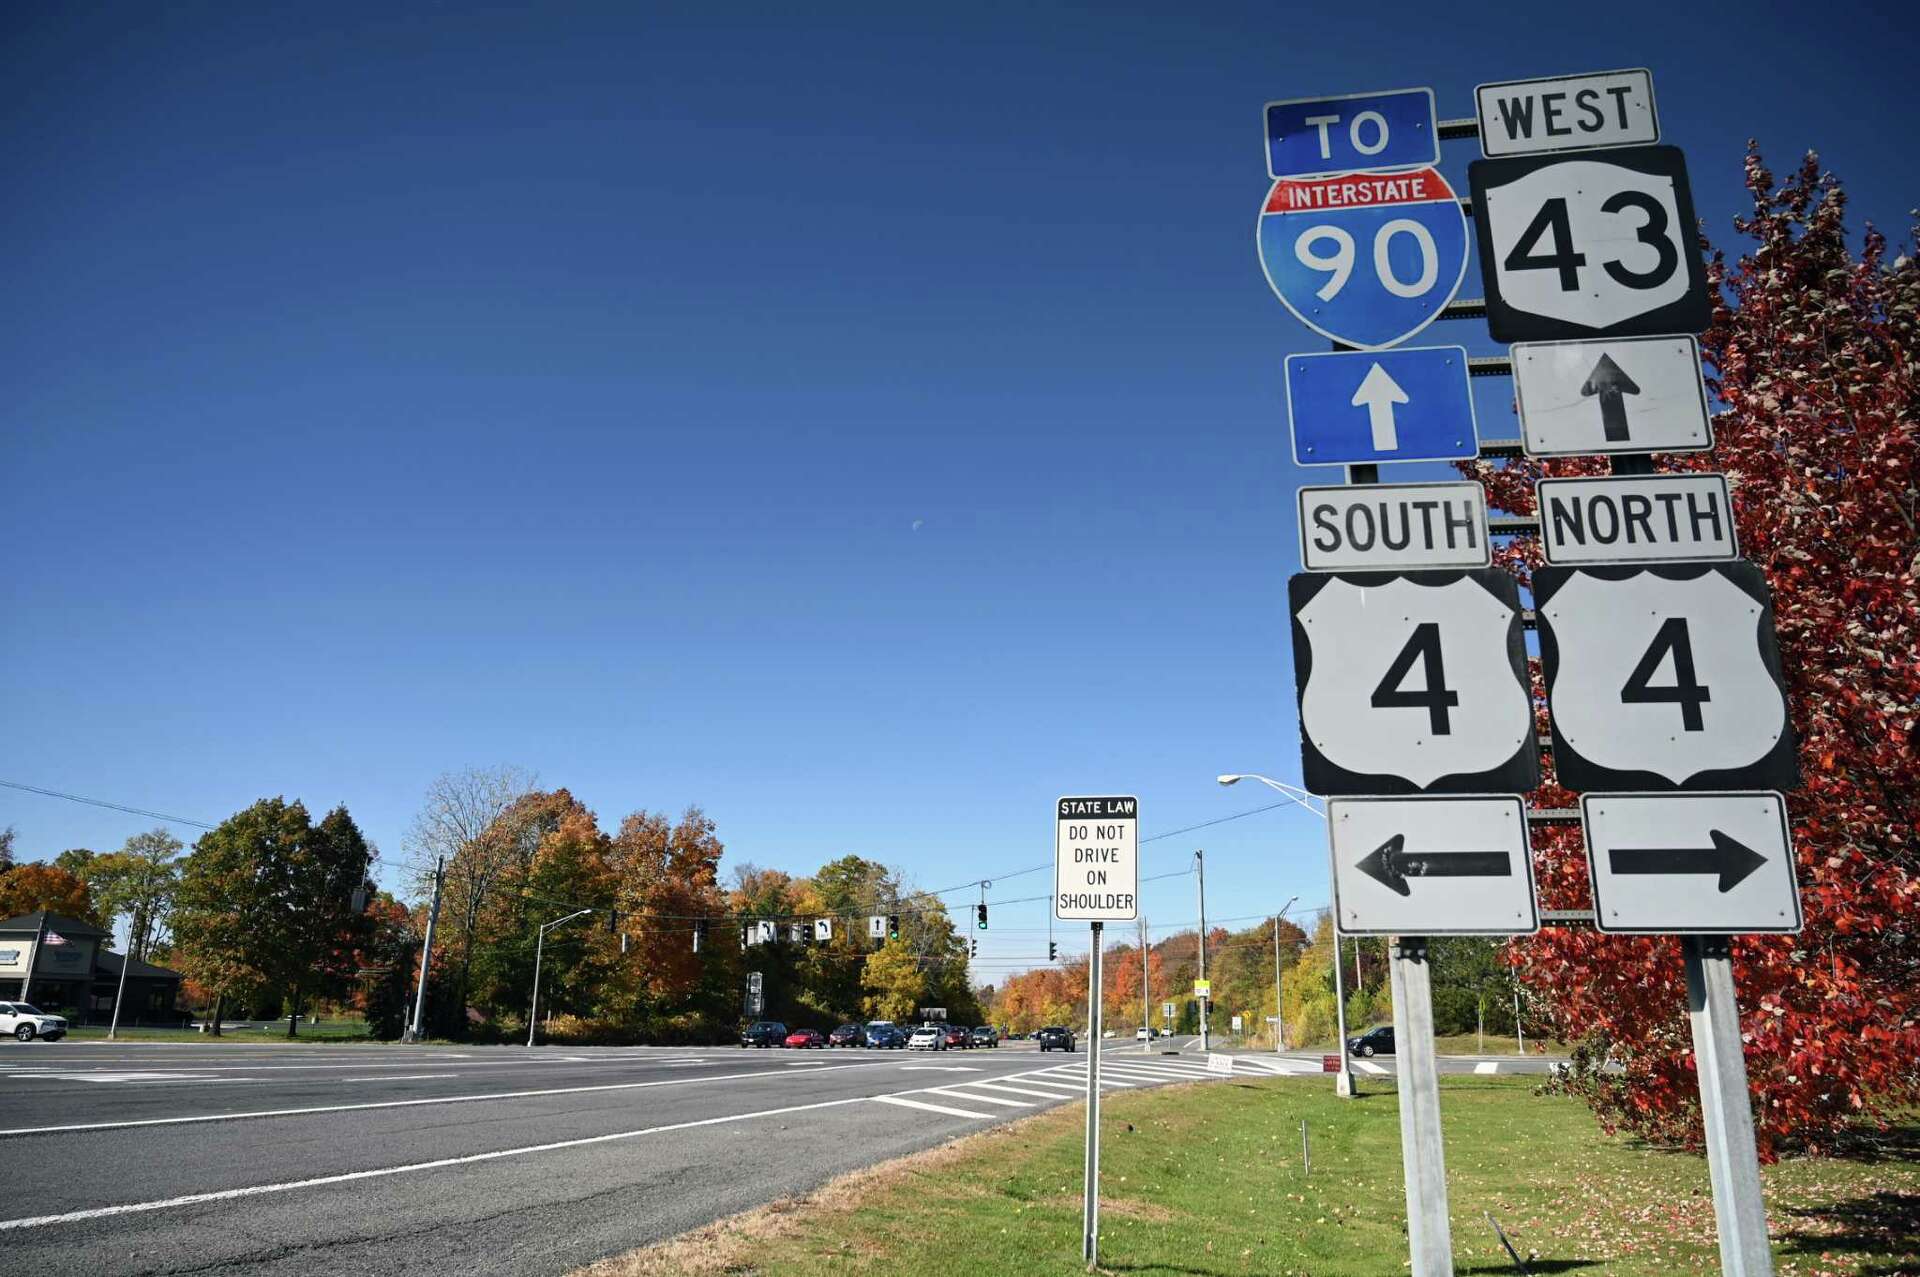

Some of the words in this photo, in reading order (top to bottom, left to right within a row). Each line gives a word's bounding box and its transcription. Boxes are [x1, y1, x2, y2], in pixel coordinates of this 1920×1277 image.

[1305, 111, 1389, 159] TO
[1498, 86, 1633, 140] WEST
[1289, 178, 1426, 208] INTERSTATE
[1294, 218, 1439, 302] 90
[1504, 190, 1678, 292] 43
[1312, 500, 1477, 553] SOUTH
[1550, 491, 1723, 546] NORTH
[1370, 622, 1459, 735] 4
[1621, 617, 1711, 731] 4
[1061, 801, 1101, 815] STATE
[1107, 801, 1134, 814] LAW
[1069, 825, 1088, 840] DO
[1097, 825, 1125, 840] NOT
[1074, 848, 1119, 863] DRIVE
[1087, 870, 1107, 885] ON
[1060, 894, 1134, 909] SHOULDER
